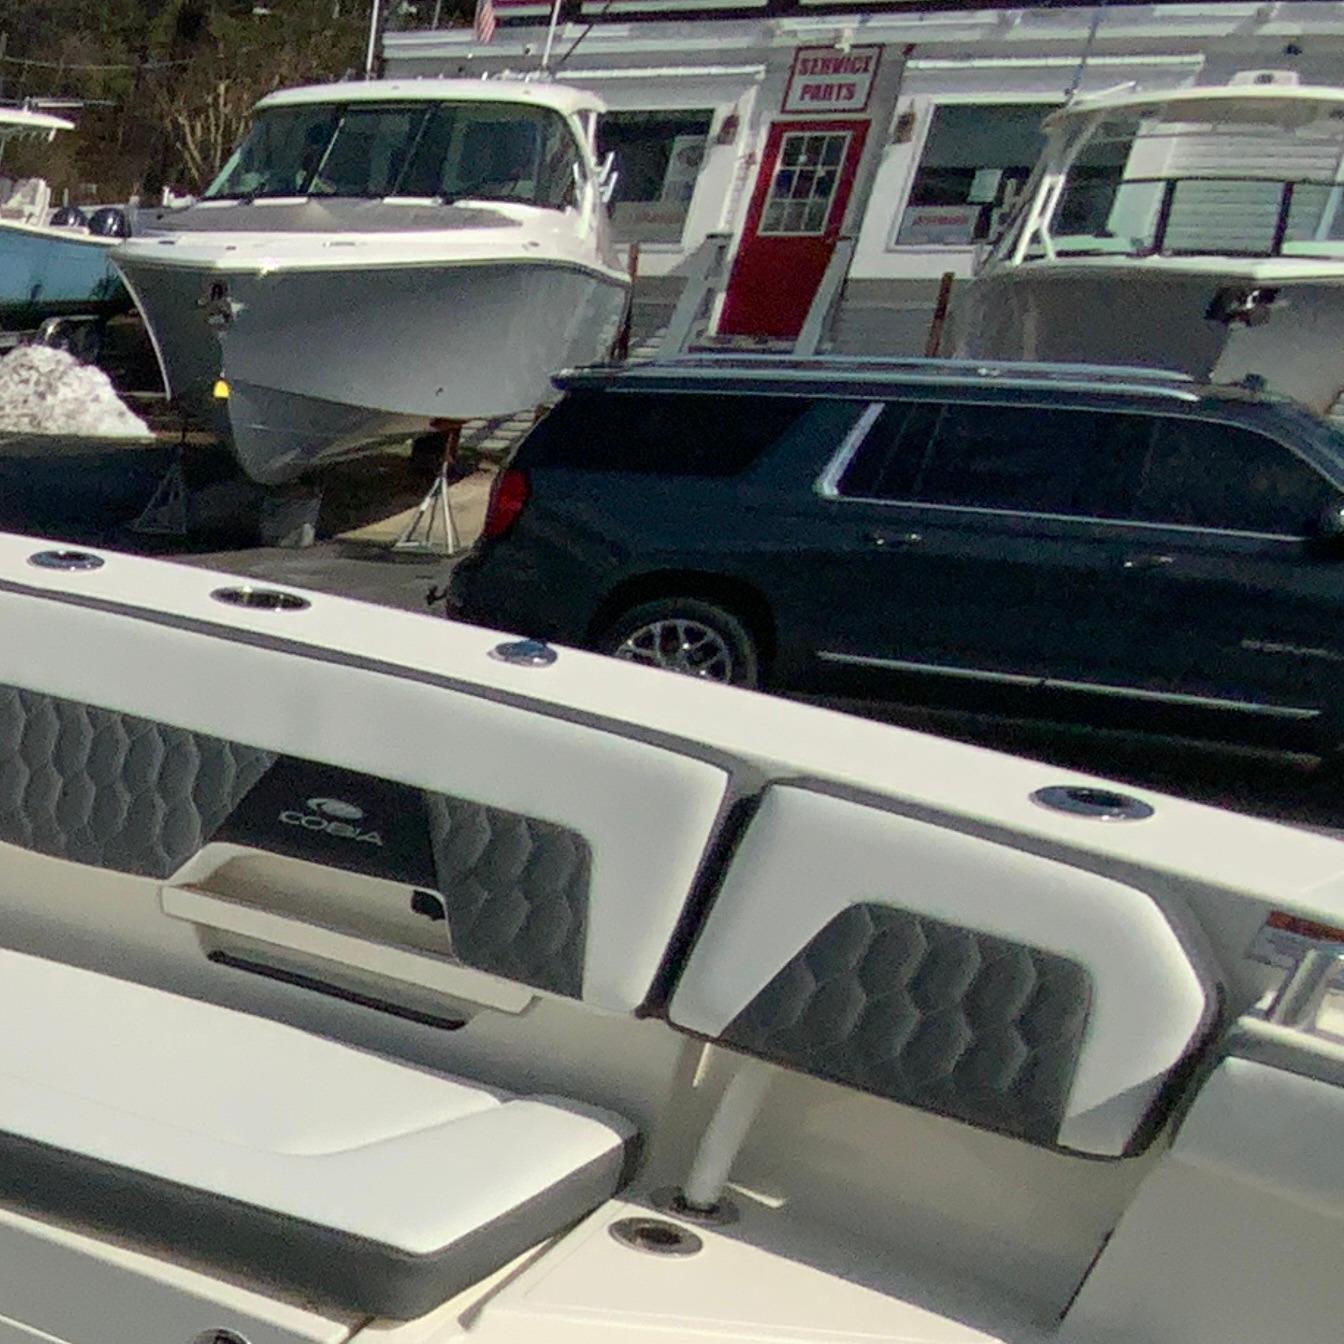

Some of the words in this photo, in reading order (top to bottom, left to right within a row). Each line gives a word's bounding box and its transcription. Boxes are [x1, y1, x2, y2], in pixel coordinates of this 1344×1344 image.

[798, 55, 873, 75] SERVICE
[799, 83, 856, 101] PARTS
[277, 810, 384, 847] COBIA
